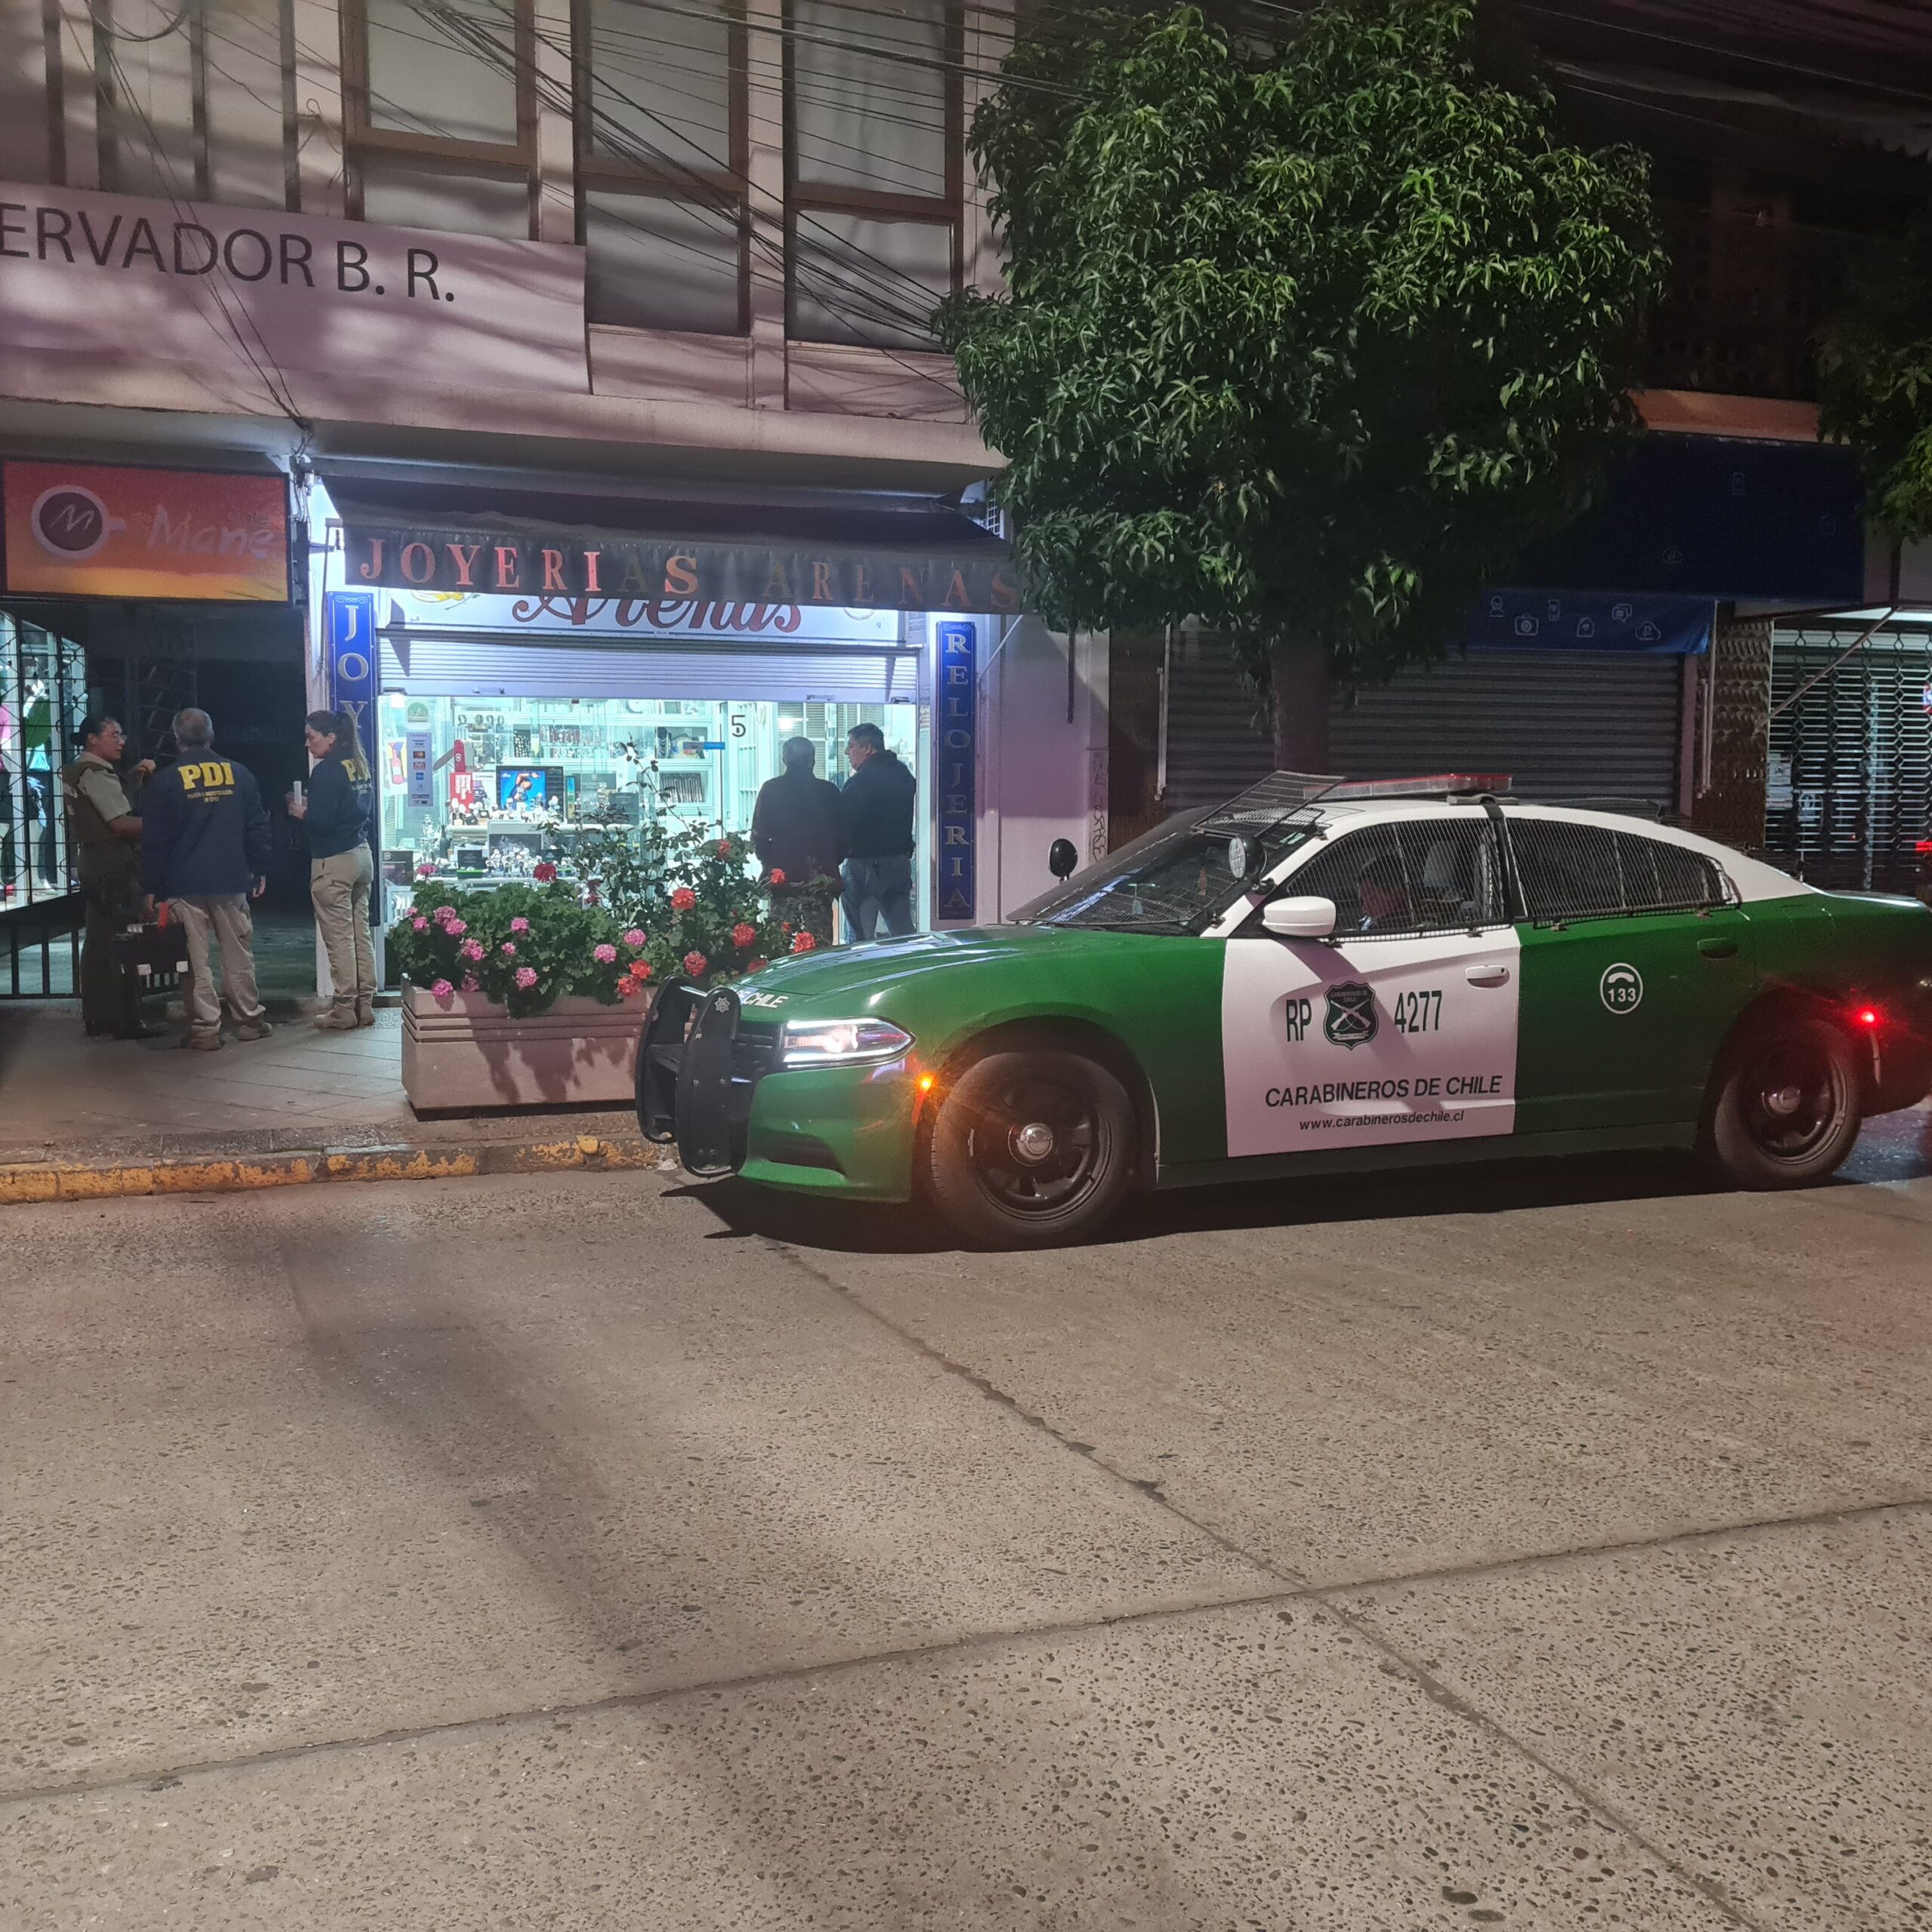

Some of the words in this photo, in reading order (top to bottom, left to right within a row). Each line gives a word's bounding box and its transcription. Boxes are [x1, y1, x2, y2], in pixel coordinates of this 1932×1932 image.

[0, 203, 314, 288] ERVADOR
[337, 240, 386, 296] B.
[406, 248, 455, 303] R.
[360, 538, 699, 595] JOYERIAS
[761, 559, 1017, 608] ARENAS
[731, 715, 746, 737] 5
[177, 761, 235, 790] PDI
[945, 633, 971, 907] RELOJERIA
[743, 992, 789, 1008] CHILE
[1607, 987, 1636, 1002] 133
[1286, 998, 1312, 1042] RP
[1394, 989, 1442, 1033] 4277
[1265, 1078, 1410, 1107] CARABINEROS
[1414, 1077, 1441, 1097] DE
[1445, 1075, 1503, 1095] CHILE
[1299, 1110, 1465, 1131] www.carabinerosdechile.cl
